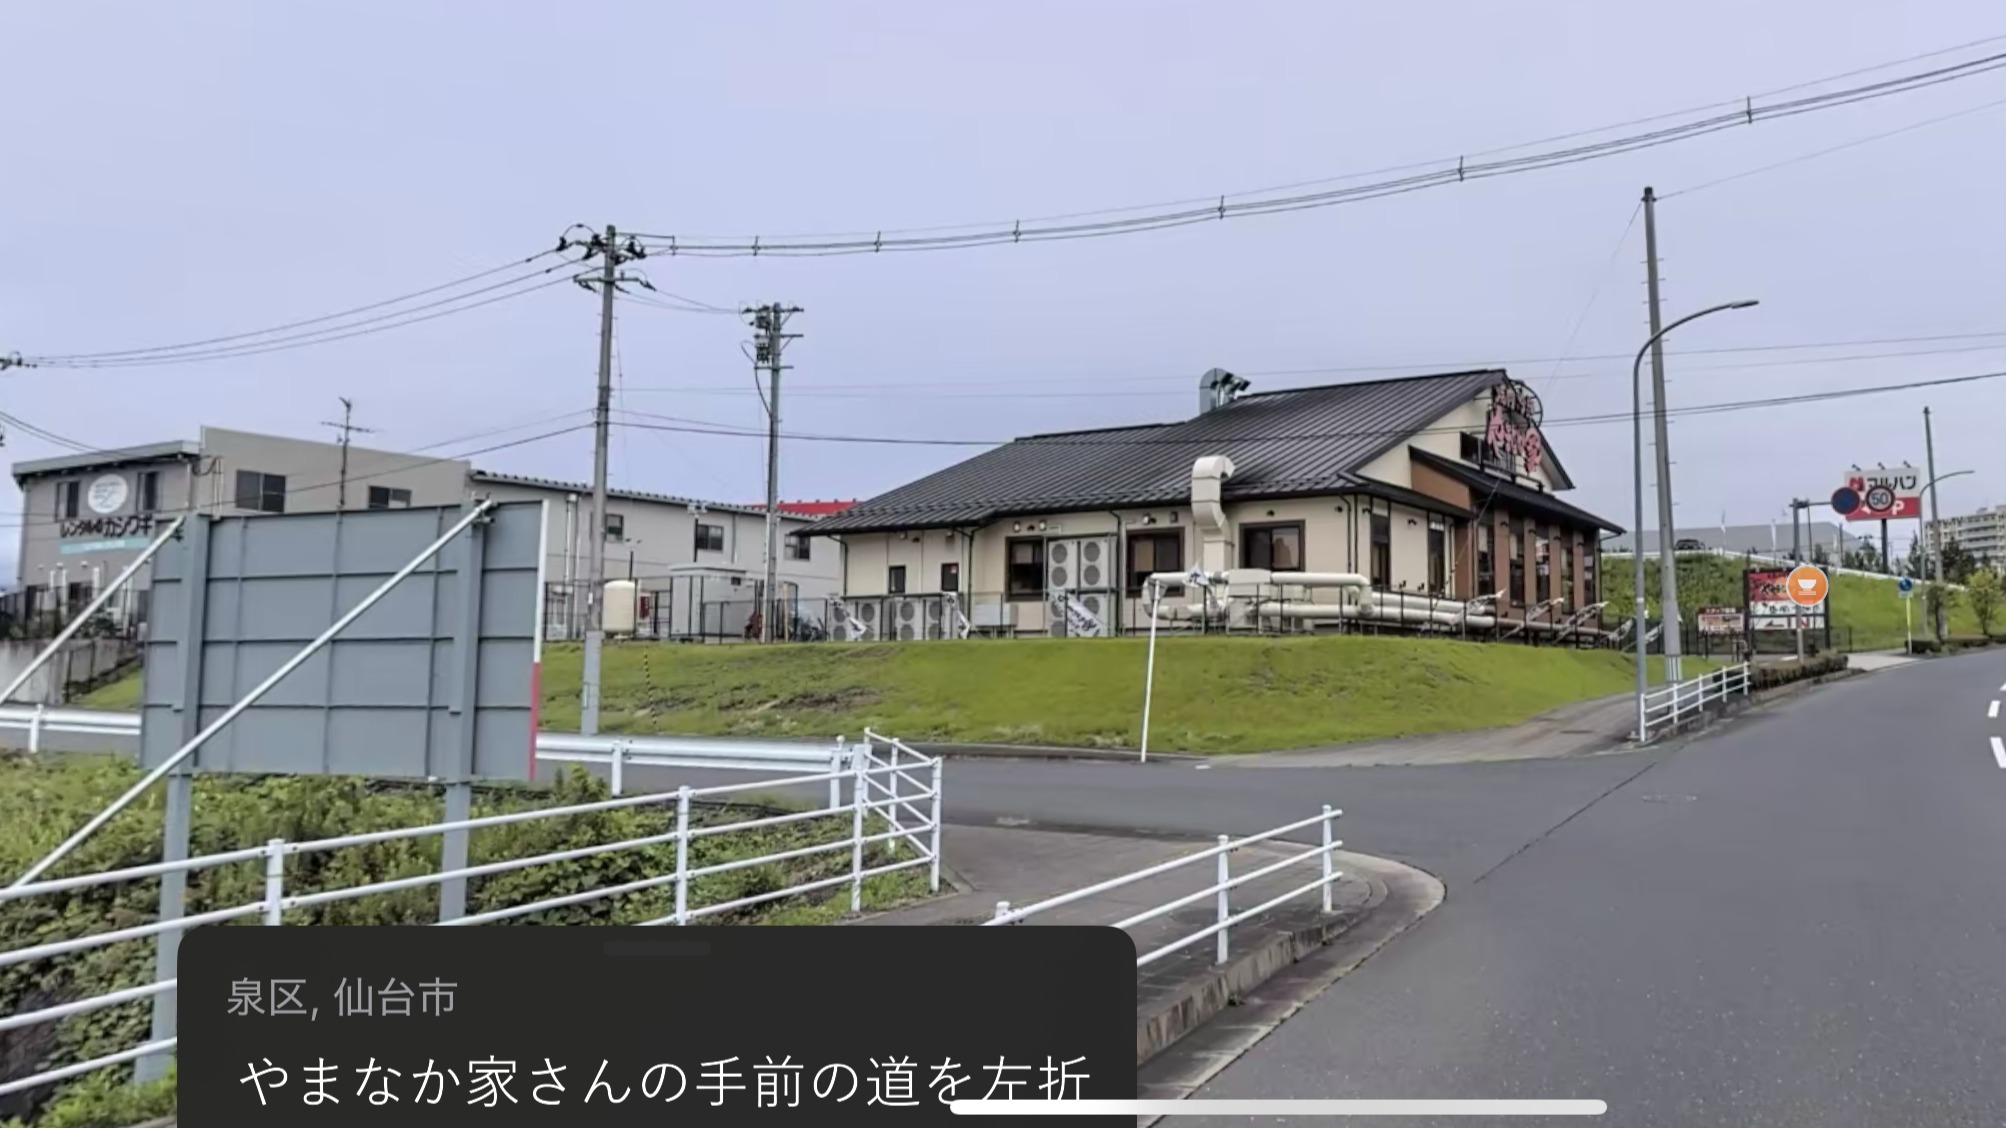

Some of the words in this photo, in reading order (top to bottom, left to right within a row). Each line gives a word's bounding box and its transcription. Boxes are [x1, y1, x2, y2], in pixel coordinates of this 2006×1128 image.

[1866, 474, 1917, 491] マルハン
[1871, 492, 1889, 506] 50
[1892, 500, 1905, 515] P
